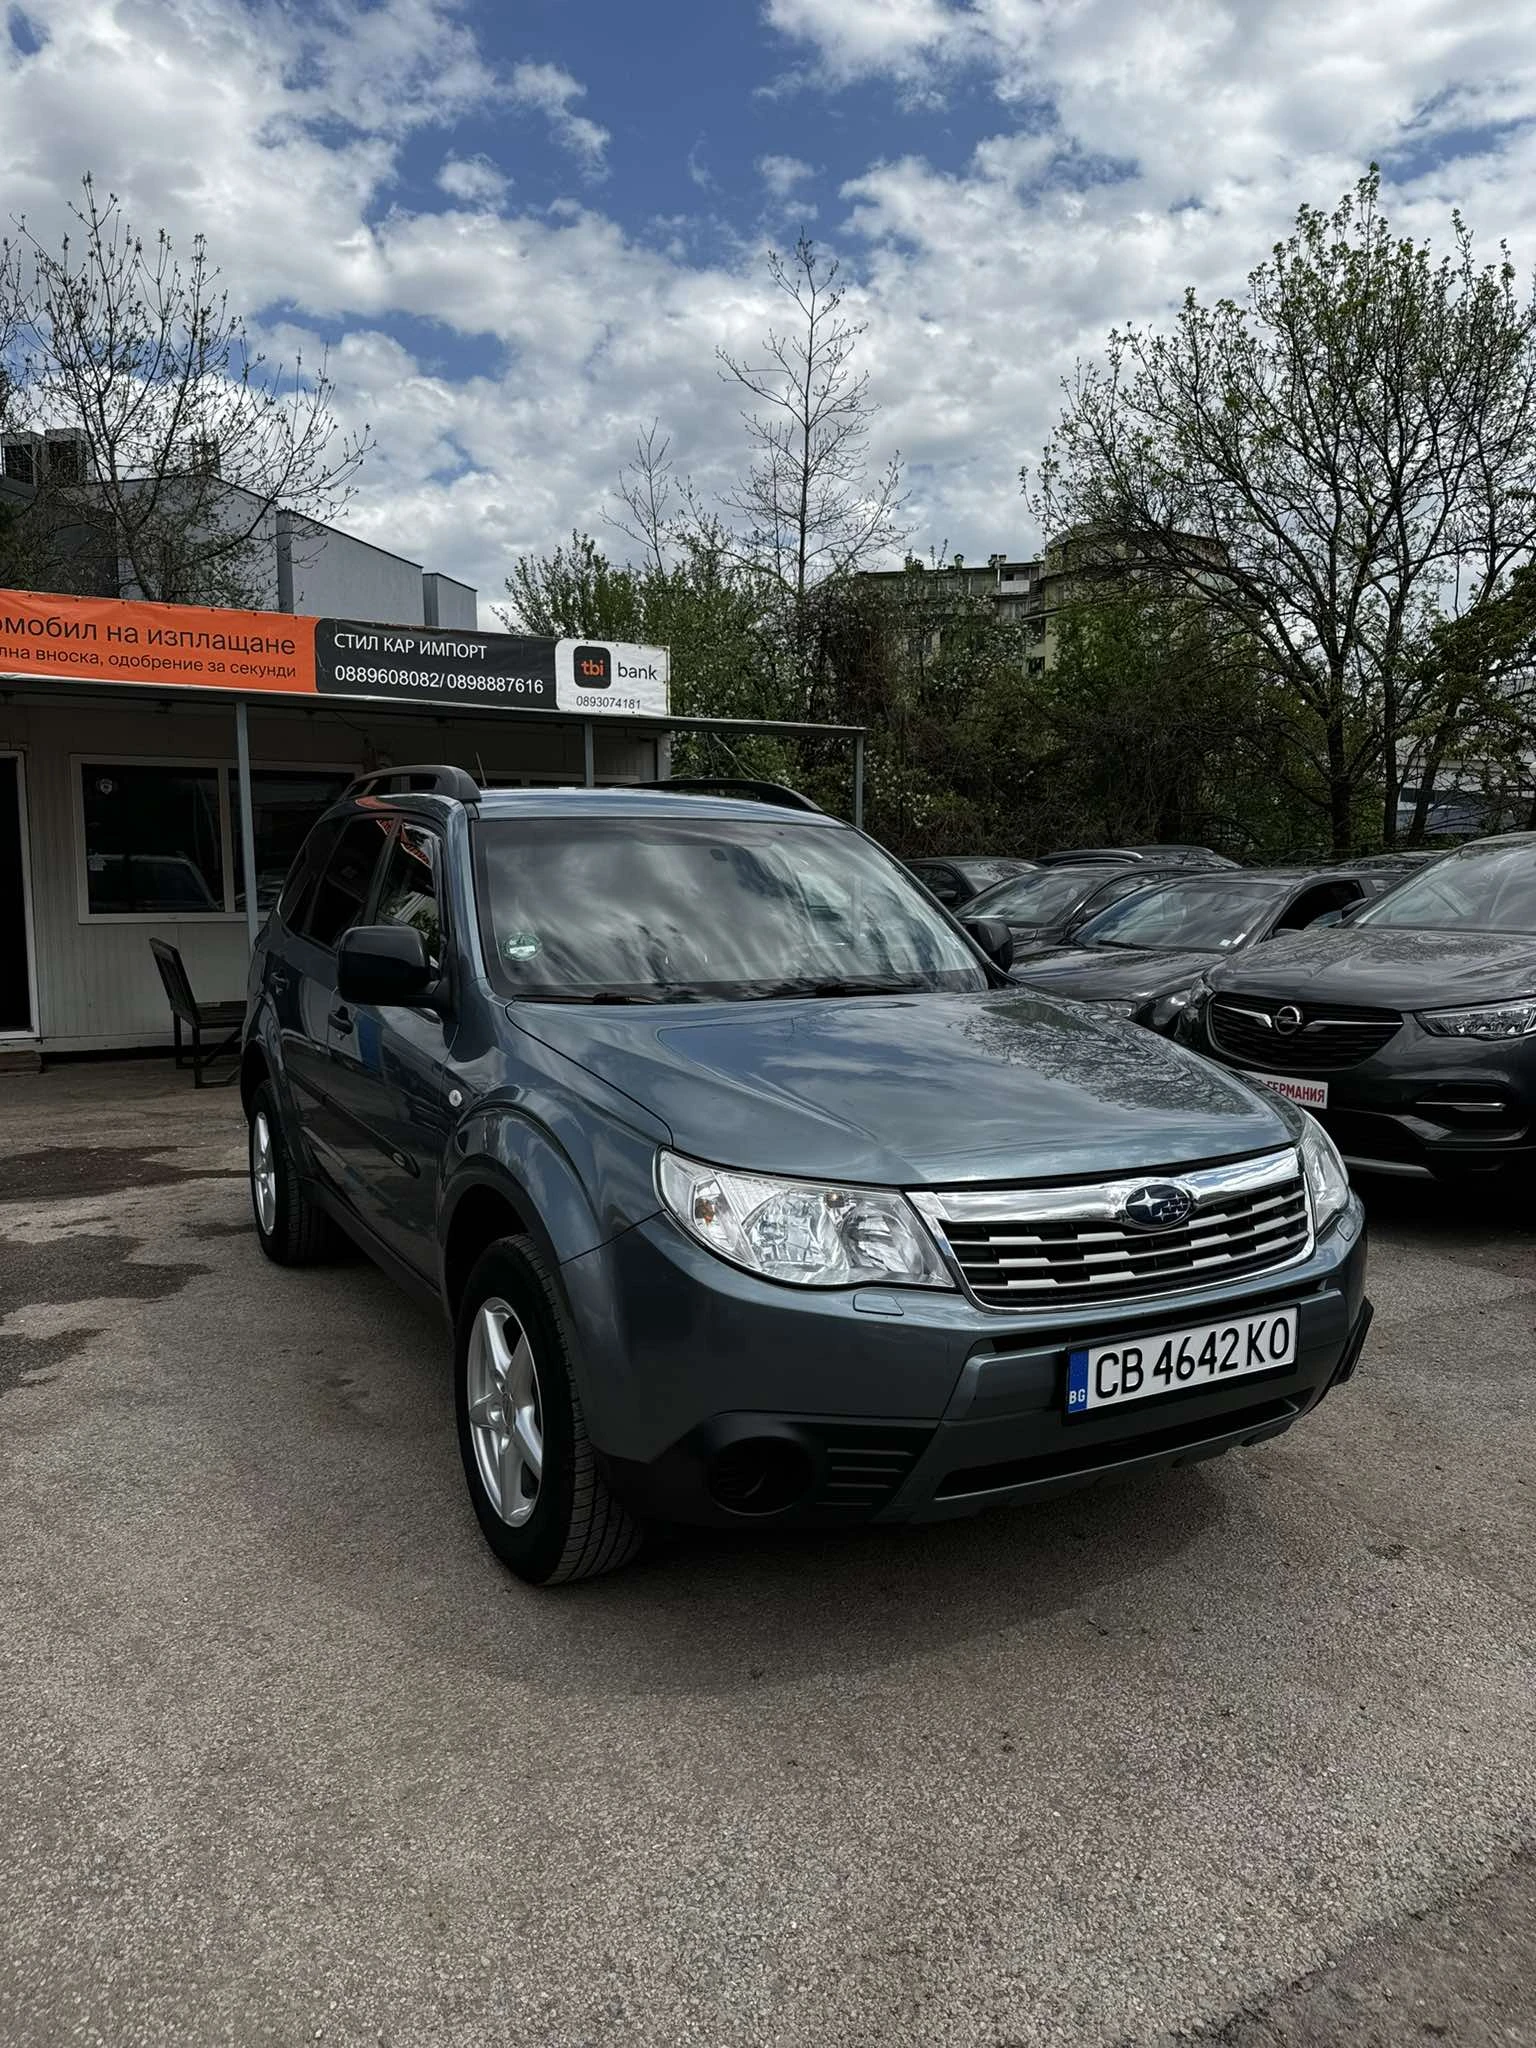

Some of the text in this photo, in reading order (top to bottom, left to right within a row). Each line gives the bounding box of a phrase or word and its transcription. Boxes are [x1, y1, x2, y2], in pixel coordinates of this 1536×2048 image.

[0, 616, 296, 655] мобил на изплащане
[334, 633, 488, 660] СТИЛ КАР ИМПОРТ
[36, 649, 104, 667] вноска,
[108, 654, 203, 672] одобрение
[208, 661, 226, 673] за
[230, 663, 296, 679] секунди
[581, 659, 658, 681] tbi bank
[335, 665, 544, 694] 0889608082/0898887616
[576, 695, 640, 710] 0893074181
[1152, 1327, 1240, 1385] 4642
[1069, 1388, 1087, 1405] BG
